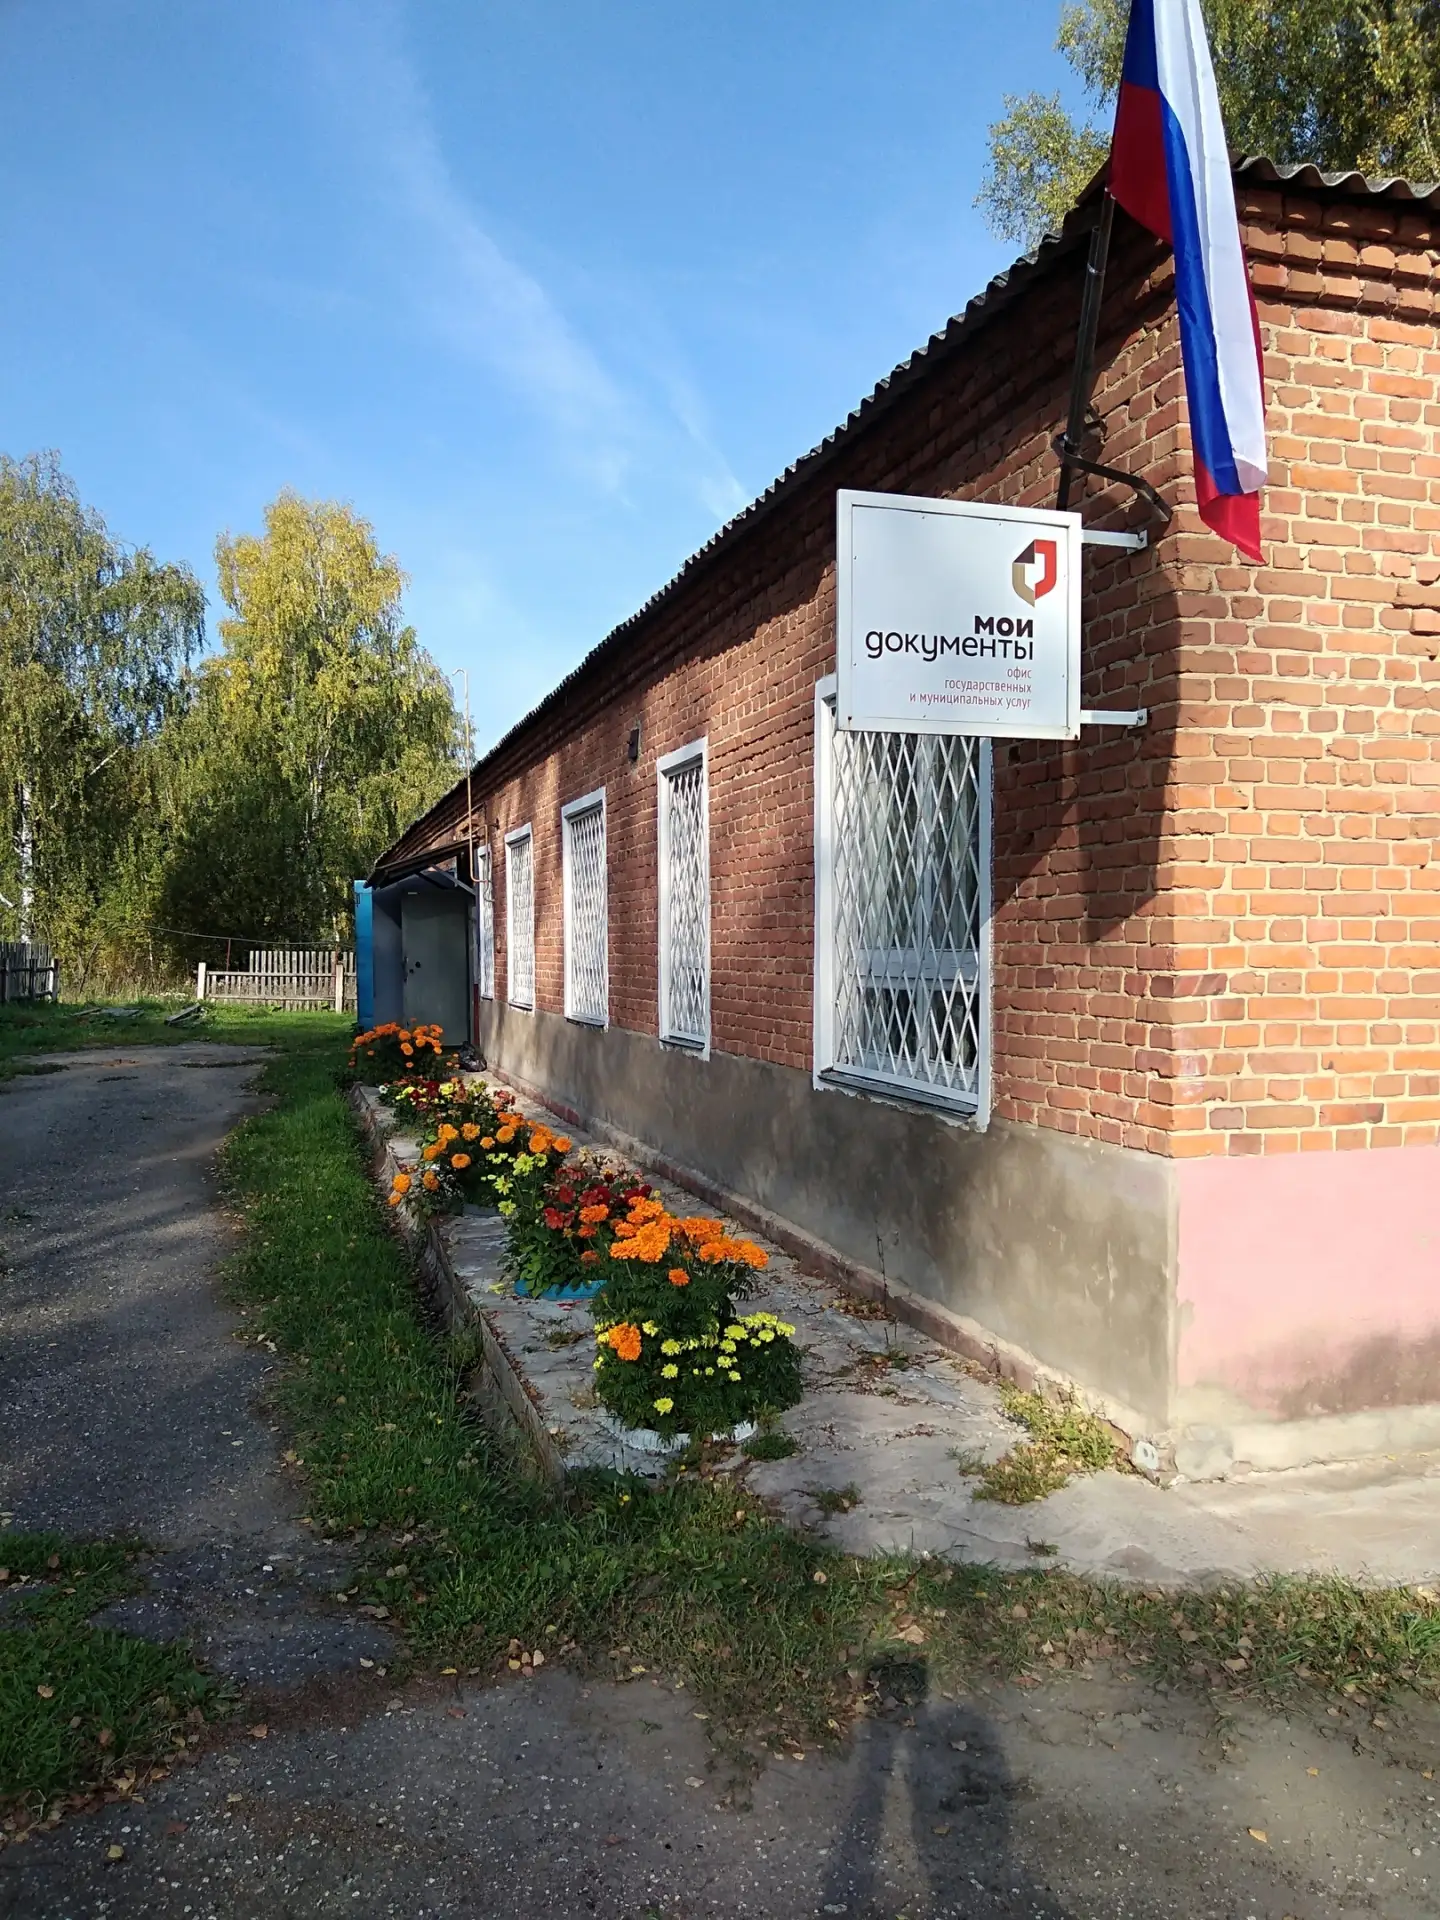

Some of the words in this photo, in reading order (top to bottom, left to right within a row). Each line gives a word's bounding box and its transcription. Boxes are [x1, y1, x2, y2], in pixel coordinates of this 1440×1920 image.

[974, 615, 1033, 638] мои
[865, 630, 1033, 662] документы
[1007, 666, 1032, 680] офис
[944, 678, 1032, 693] государственных
[910, 693, 916, 702] и
[919, 693, 1003, 707] муниципальных
[1005, 696, 1032, 710] услуг
